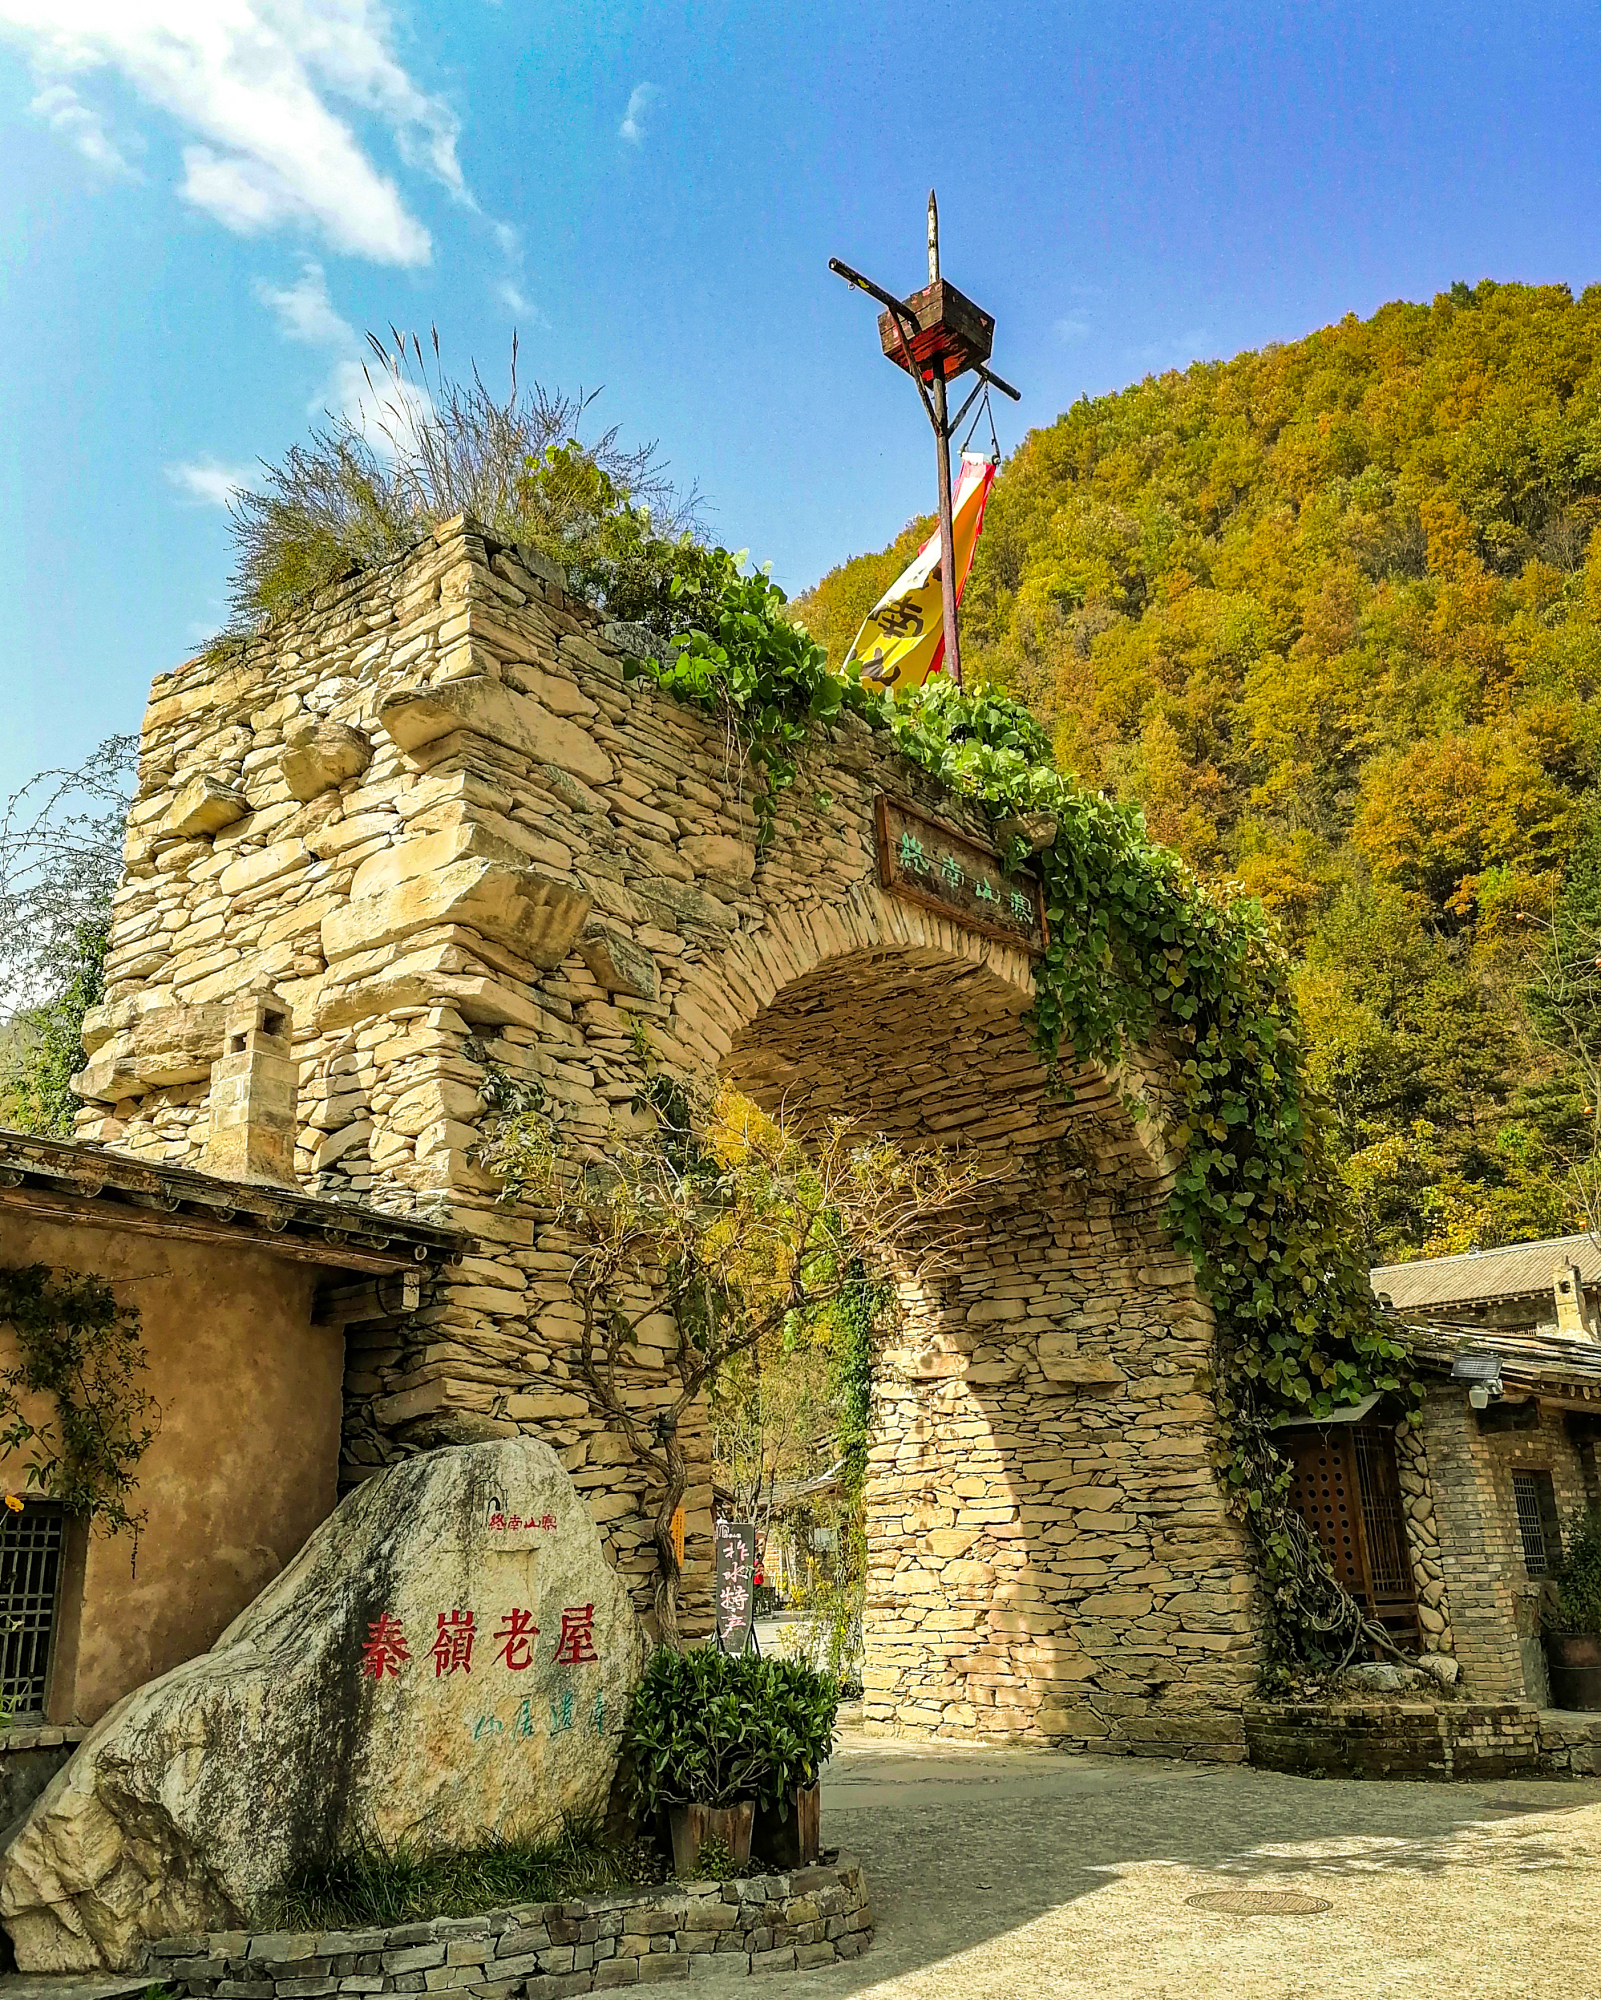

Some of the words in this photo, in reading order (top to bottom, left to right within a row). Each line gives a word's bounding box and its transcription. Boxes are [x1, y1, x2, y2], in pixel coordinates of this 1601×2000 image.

[720, 1540, 750, 1638] 柞水特产
[358, 1603, 599, 1680] 秦嶺老屋
